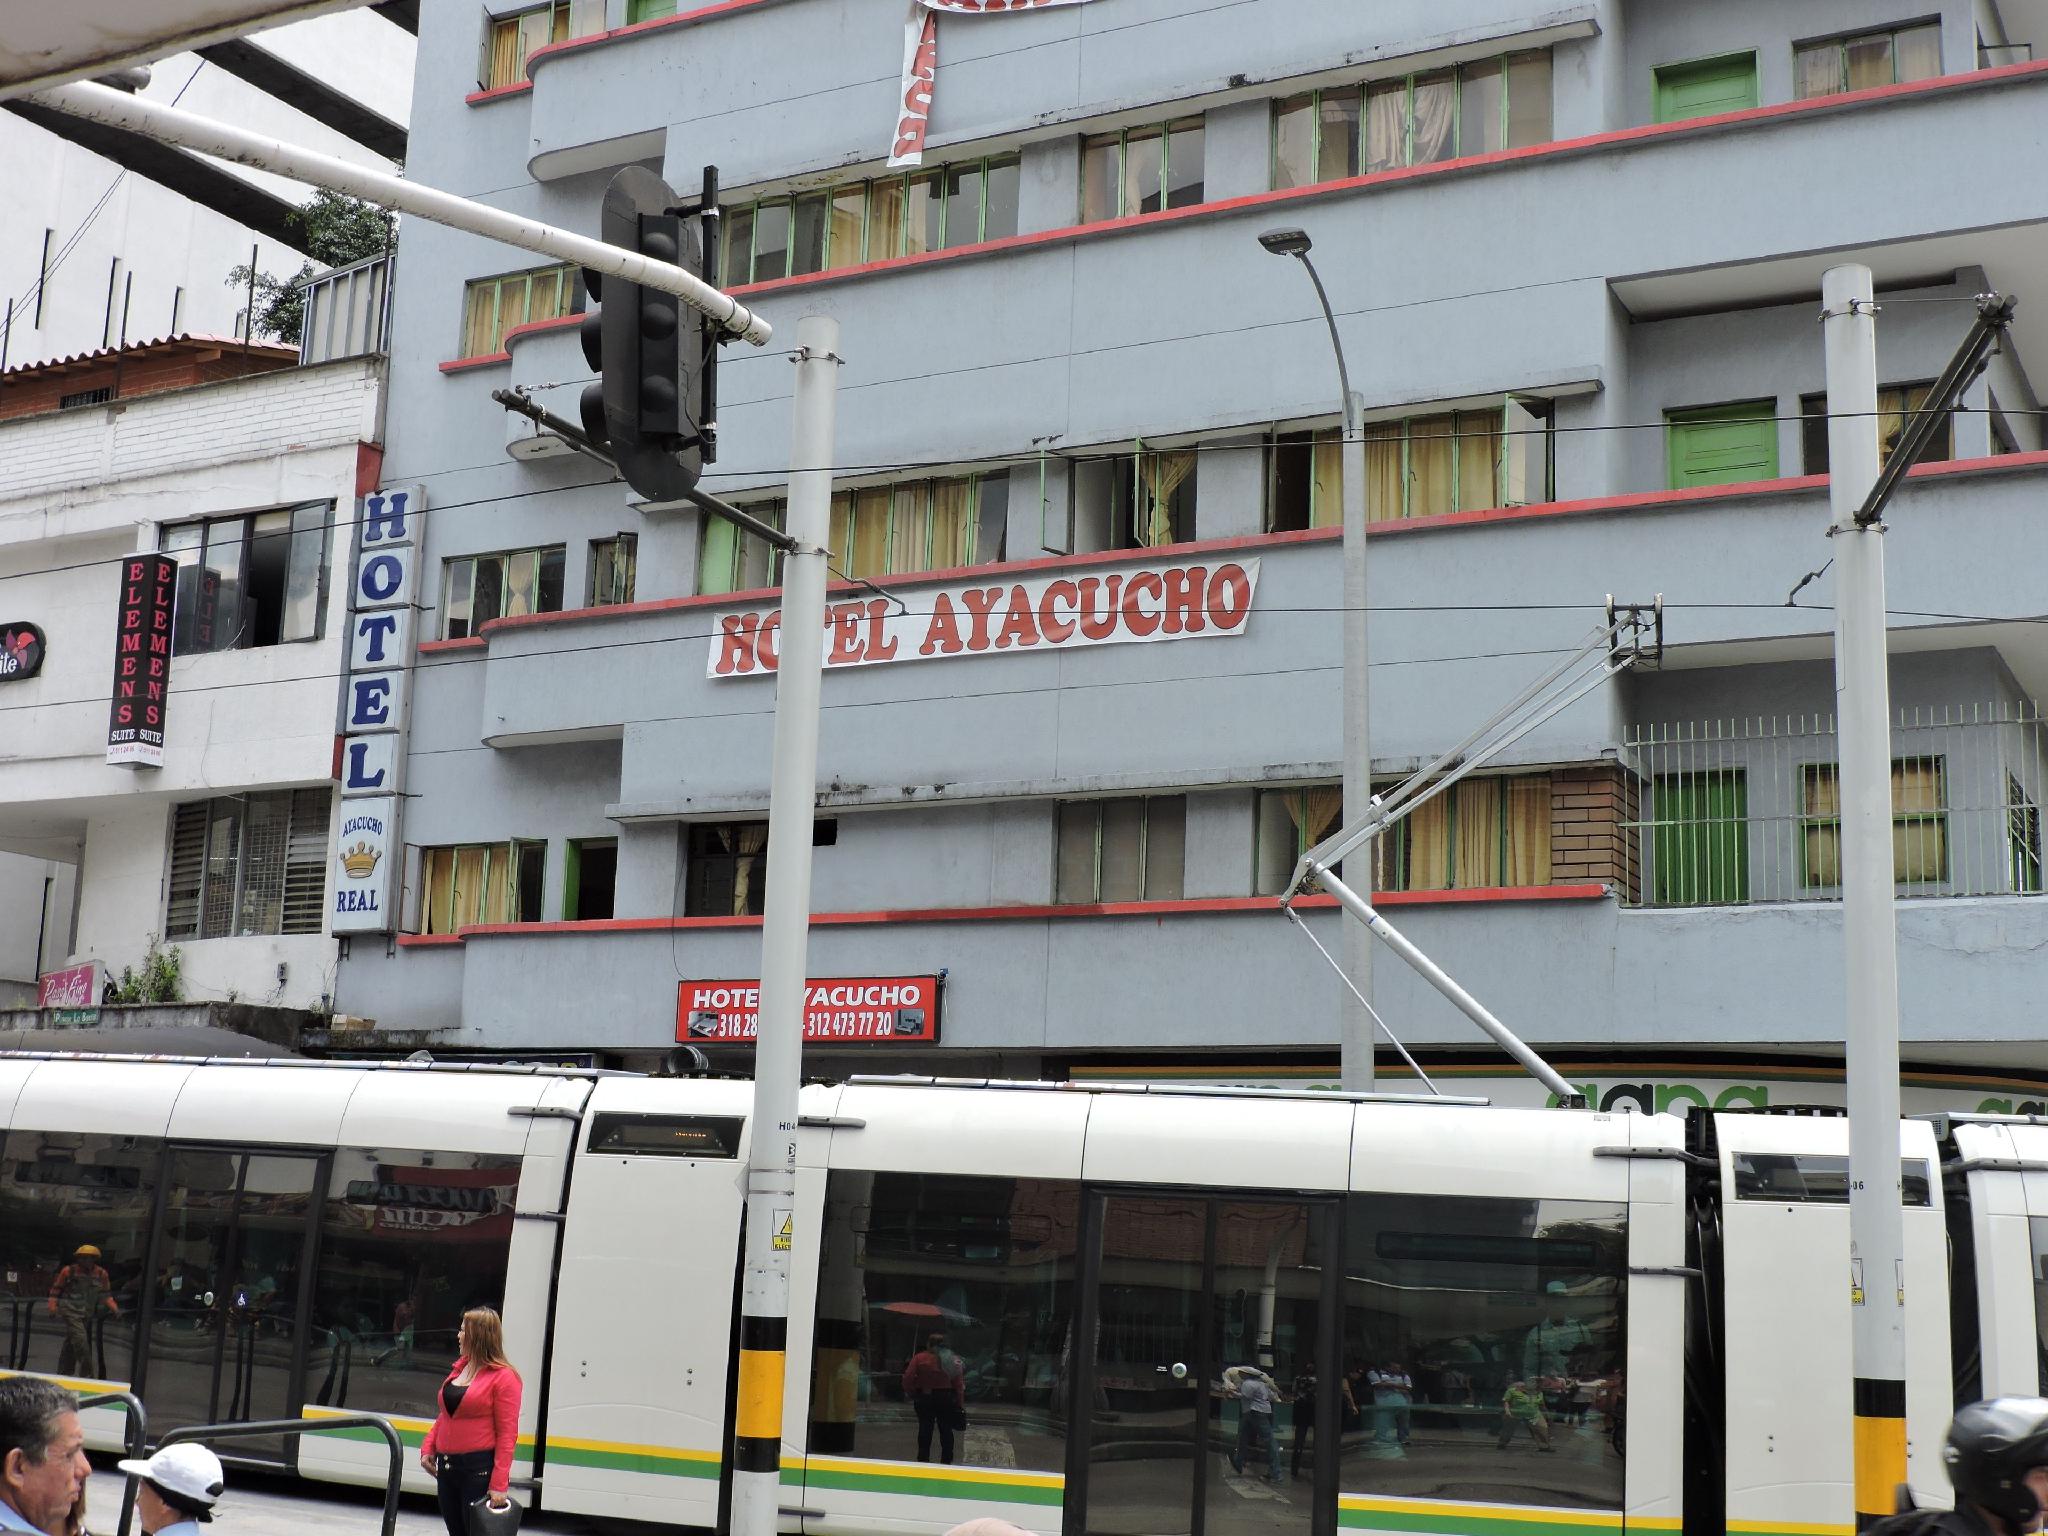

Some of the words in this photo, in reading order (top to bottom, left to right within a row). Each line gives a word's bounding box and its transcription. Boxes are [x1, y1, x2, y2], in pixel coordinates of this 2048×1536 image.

[715, 598, 898, 675] HOEL
[919, 563, 1252, 656] AYACUCHO
[118, 563, 144, 724] ELEMENS
[146, 563, 171, 724] ELEMENS
[346, 492, 409, 789] HOTEL
[111, 728, 135, 742] SUITE
[140, 728, 162, 743] SUITE
[342, 816, 383, 838] AYACUCHO
[336, 889, 379, 912] REAL
[693, 988, 758, 1008] HOTE
[803, 985, 920, 1007] YACUCHO
[719, 1013, 741, 1037] 318
[743, 1013, 757, 1037] 28
[808, 1012, 831, 1037] 312
[833, 1011, 856, 1036] 473
[858, 1011, 875, 1036] 77
[876, 1011, 892, 1036] 20
